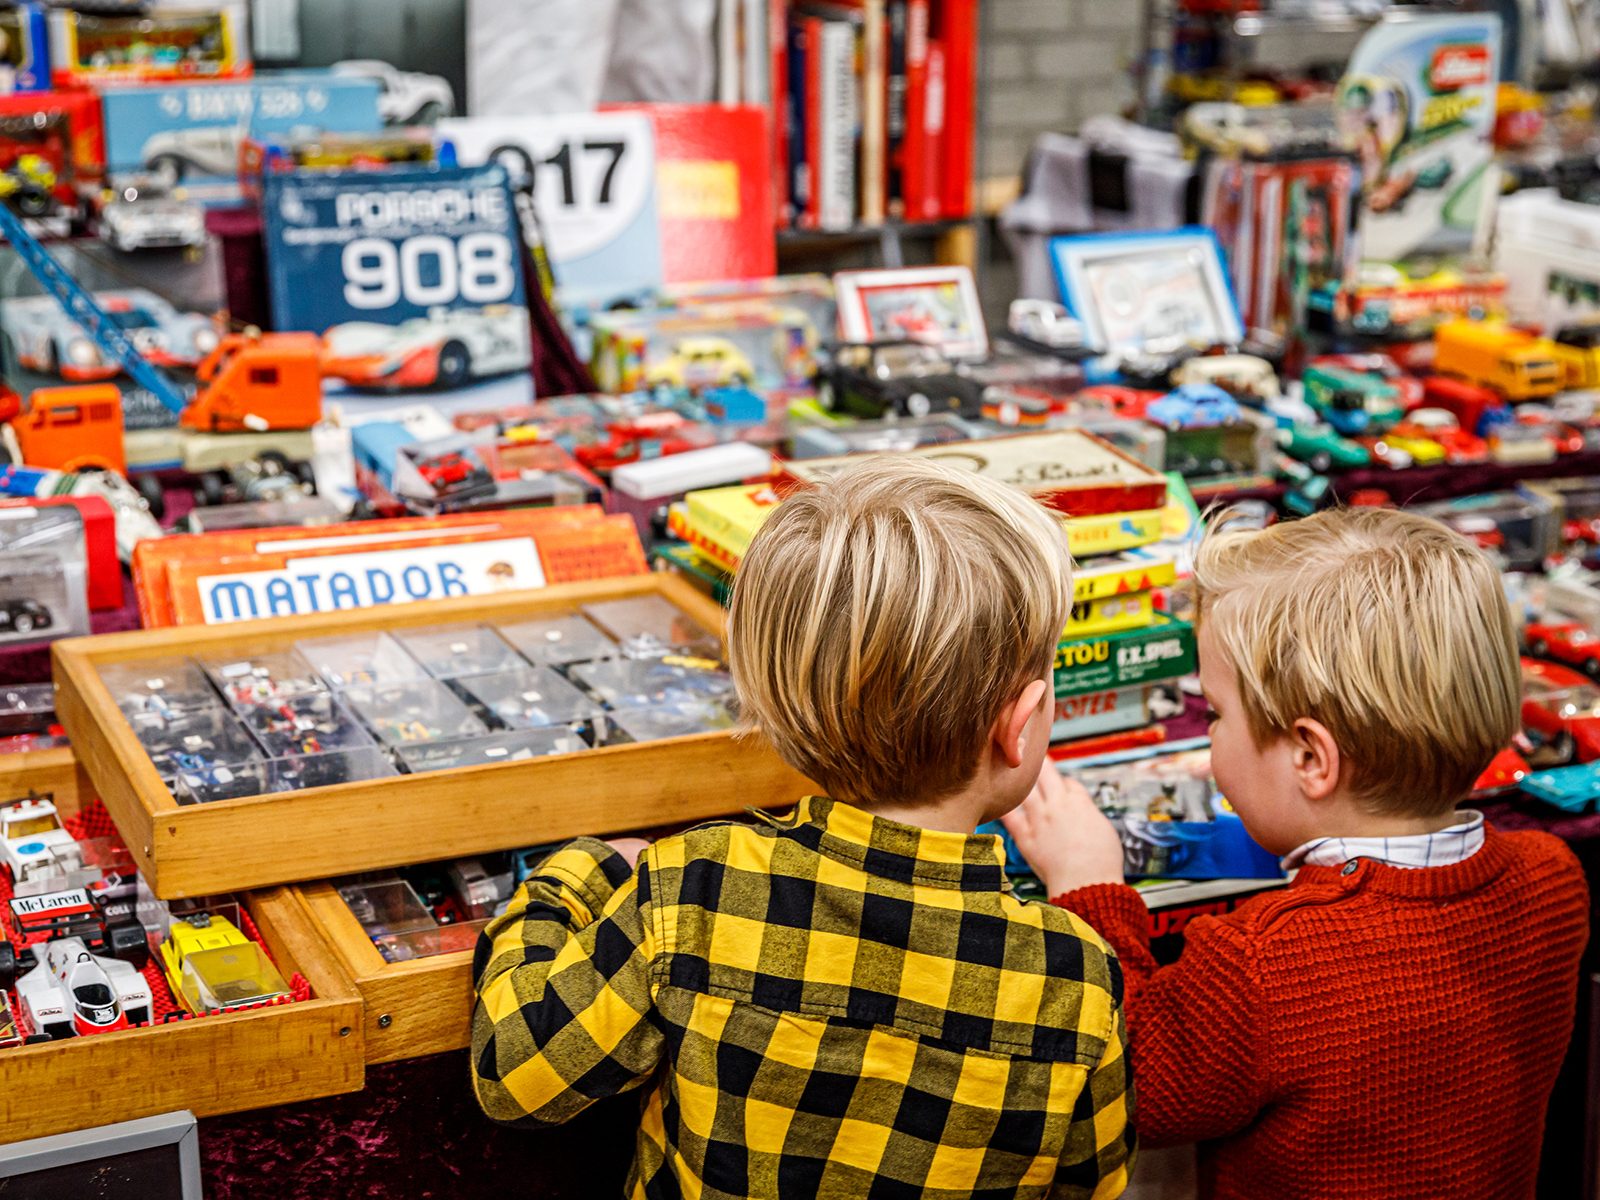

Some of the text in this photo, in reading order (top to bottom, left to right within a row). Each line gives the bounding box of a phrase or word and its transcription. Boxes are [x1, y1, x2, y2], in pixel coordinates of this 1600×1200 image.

[335, 186, 508, 230] PORSCHE
[341, 232, 515, 309] 908
[210, 561, 470, 620] MATADOR
[18, 892, 83, 913] McLaren
